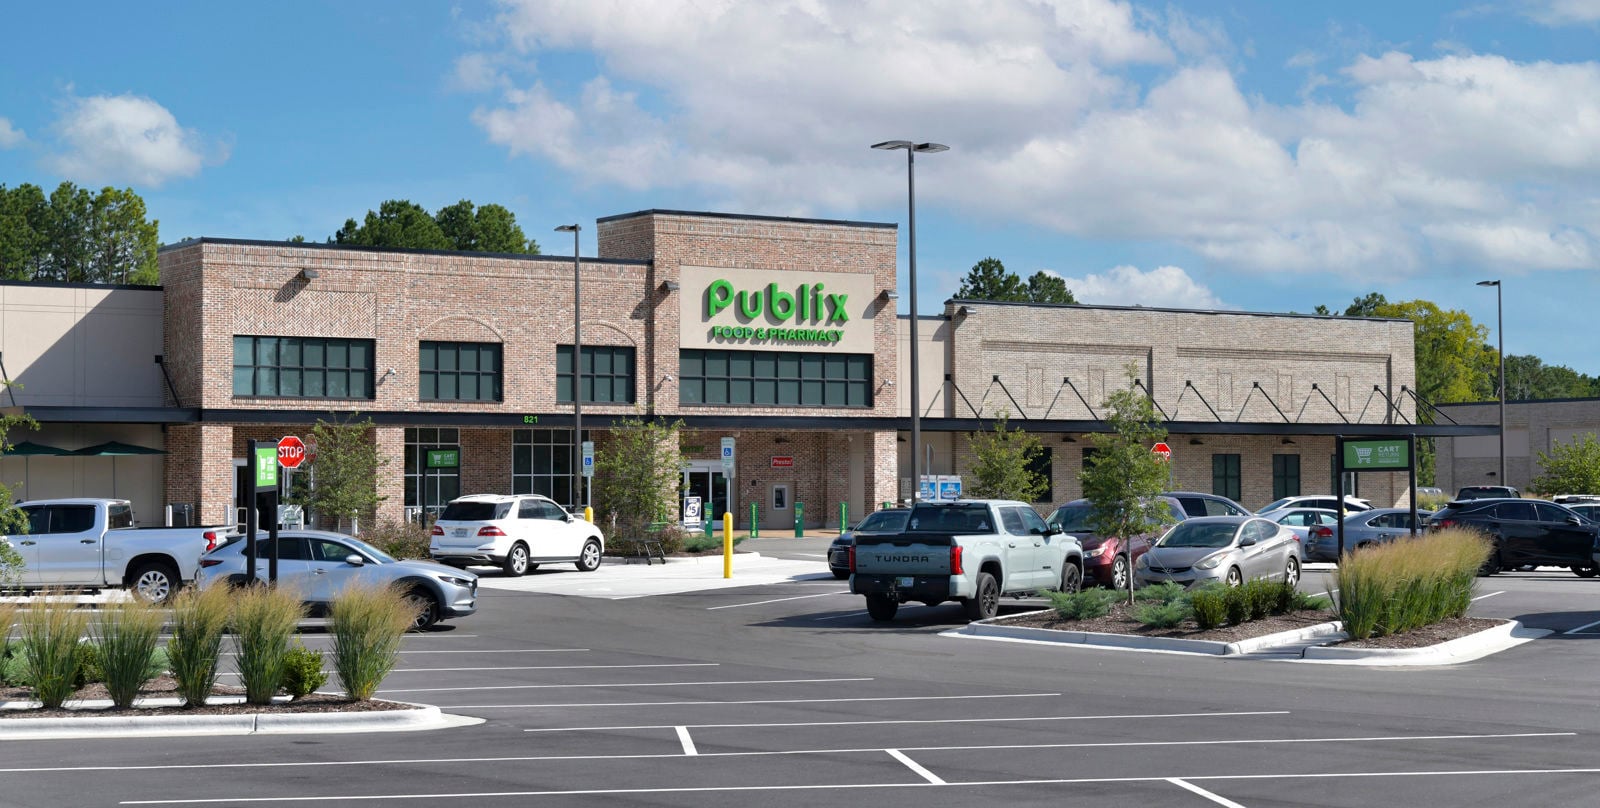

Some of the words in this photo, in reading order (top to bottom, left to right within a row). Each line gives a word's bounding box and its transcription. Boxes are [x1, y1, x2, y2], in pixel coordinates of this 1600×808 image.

[708, 279, 849, 321] Publix
[714, 325, 754, 339] FOOD
[757, 327, 766, 340] &
[769, 328, 844, 342] PHARMACY
[524, 415, 538, 424] 821
[278, 446, 303, 458] STOP
[1377, 445, 1400, 453] CART
[773, 458, 793, 466] Presto!
[875, 555, 929, 563] TUNDRA
